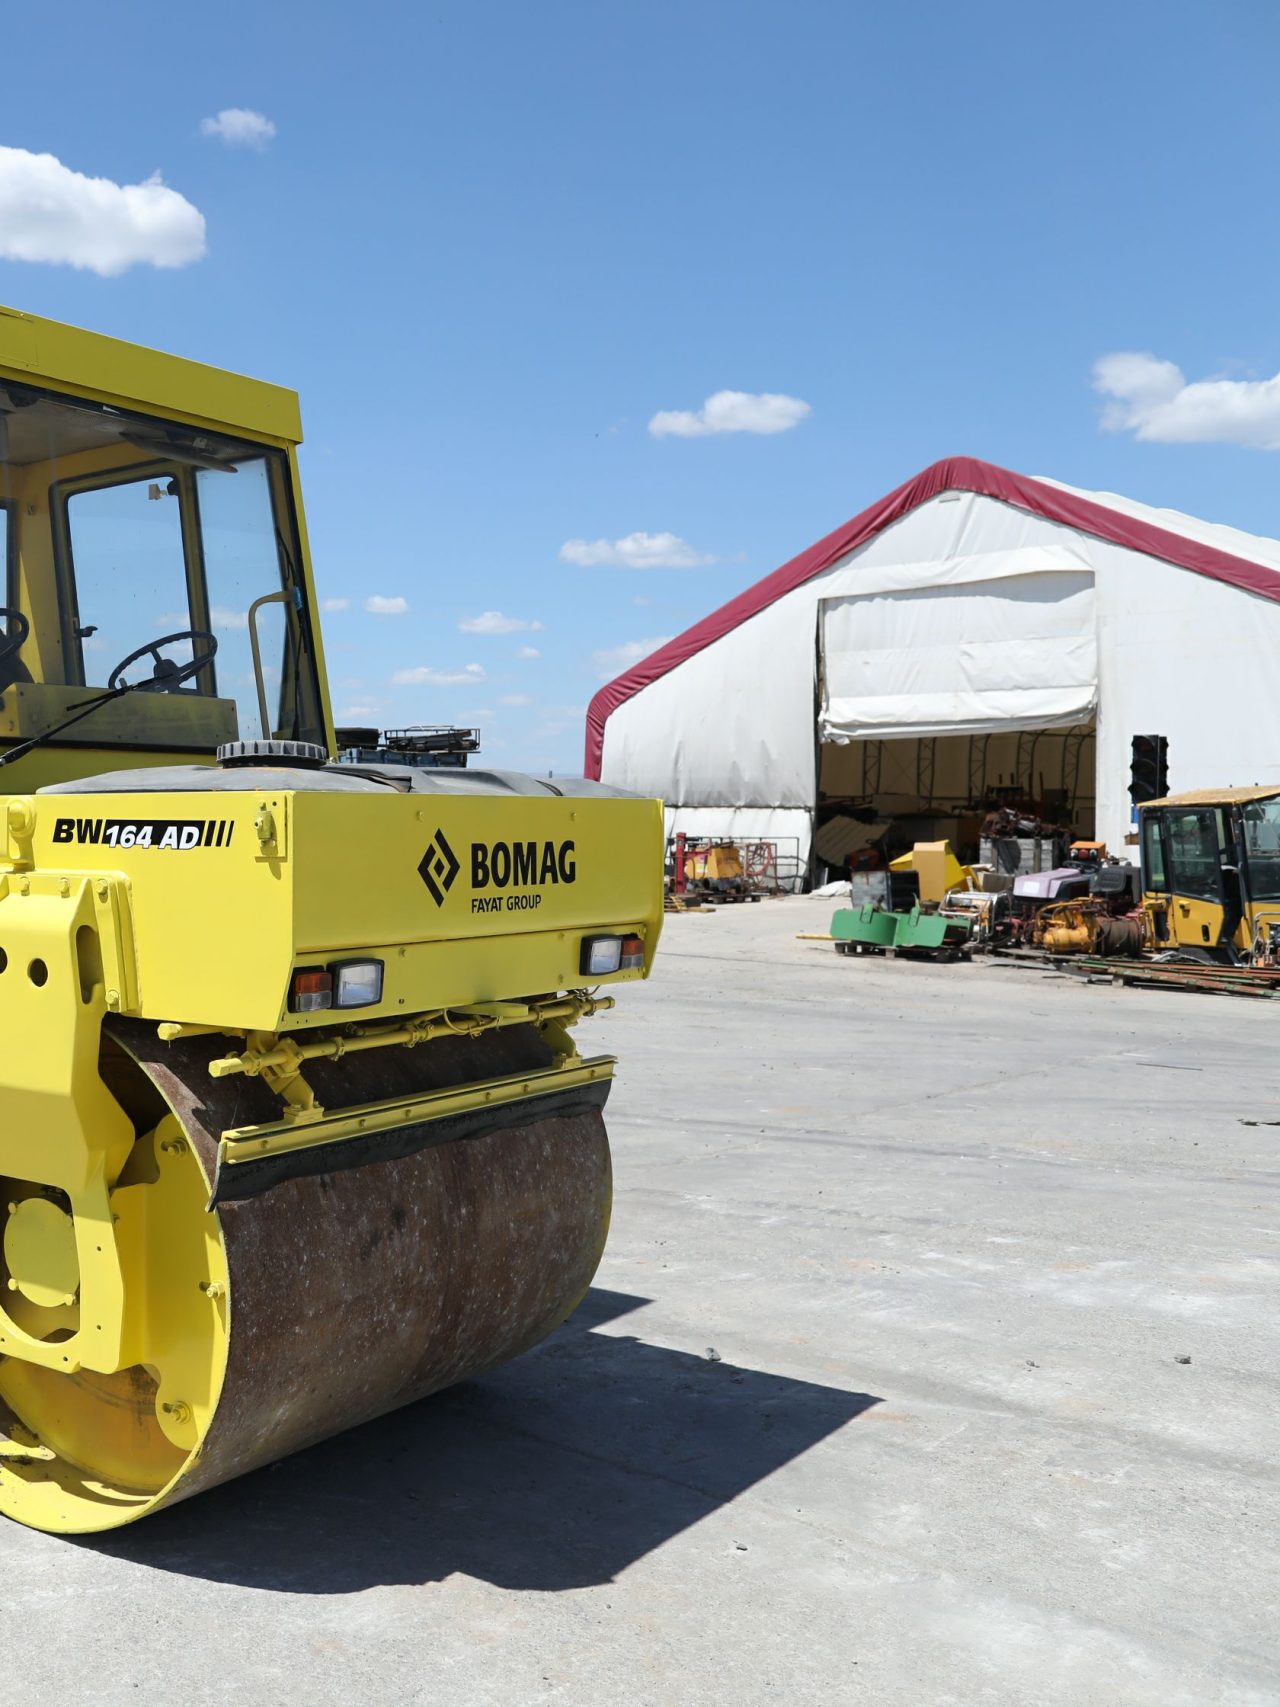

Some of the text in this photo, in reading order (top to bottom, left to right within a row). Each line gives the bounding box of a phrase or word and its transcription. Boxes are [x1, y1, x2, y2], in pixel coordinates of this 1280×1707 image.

[471, 839, 576, 889] BOMAG
[471, 894, 542, 914] FAYAT GROUP
